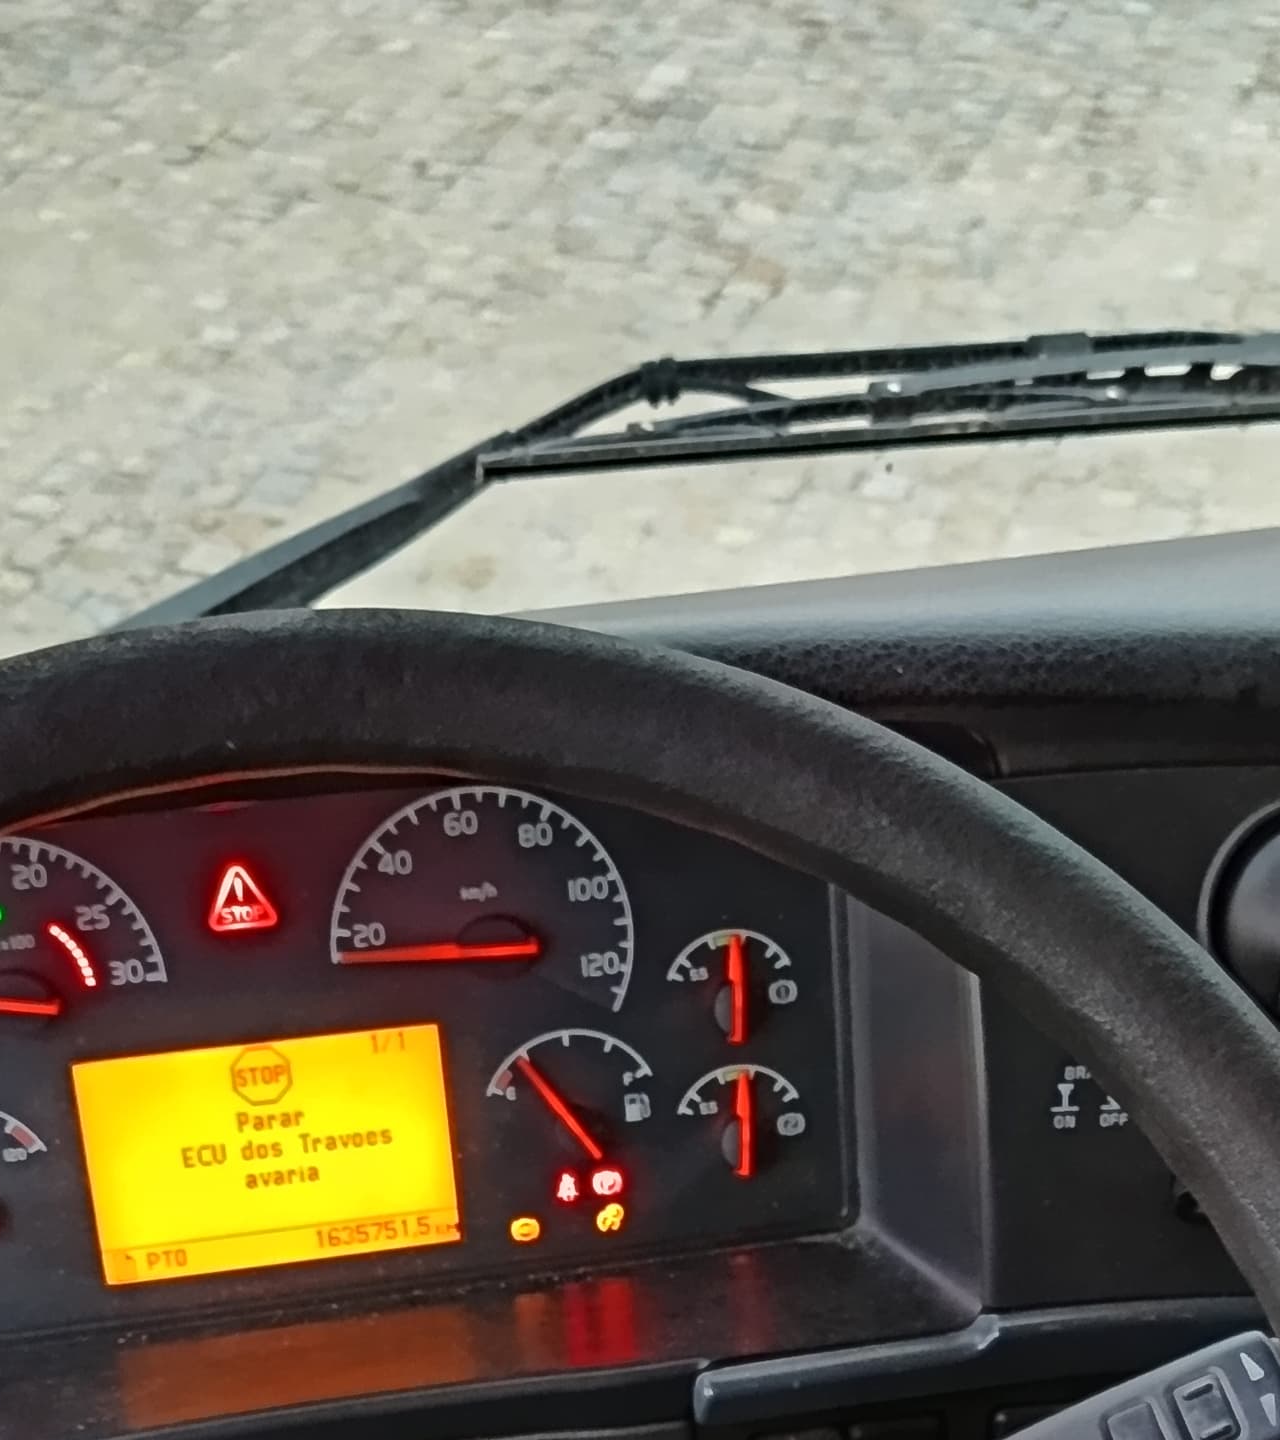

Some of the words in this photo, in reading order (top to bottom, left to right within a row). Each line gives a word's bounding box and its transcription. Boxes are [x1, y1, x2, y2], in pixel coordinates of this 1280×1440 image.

[443, 810, 478, 837] 60
[518, 822, 553, 848] 80
[377, 849, 413, 876] 40
[11, 863, 48, 890] 20
[568, 876, 609, 902] 100
[75, 903, 111, 931] 25
[352, 922, 387, 948] 20
[109, 959, 145, 986] 30
[580, 951, 620, 977] 120
[371, 1032, 405, 1054] 1/1
[235, 1064, 287, 1088] STOP
[235, 1109, 305, 1133] Parar
[181, 1143, 228, 1169] ECU
[240, 1138, 284, 1162] dos
[298, 1128, 394, 1154] Travoes
[244, 1165, 321, 1190] avaria
